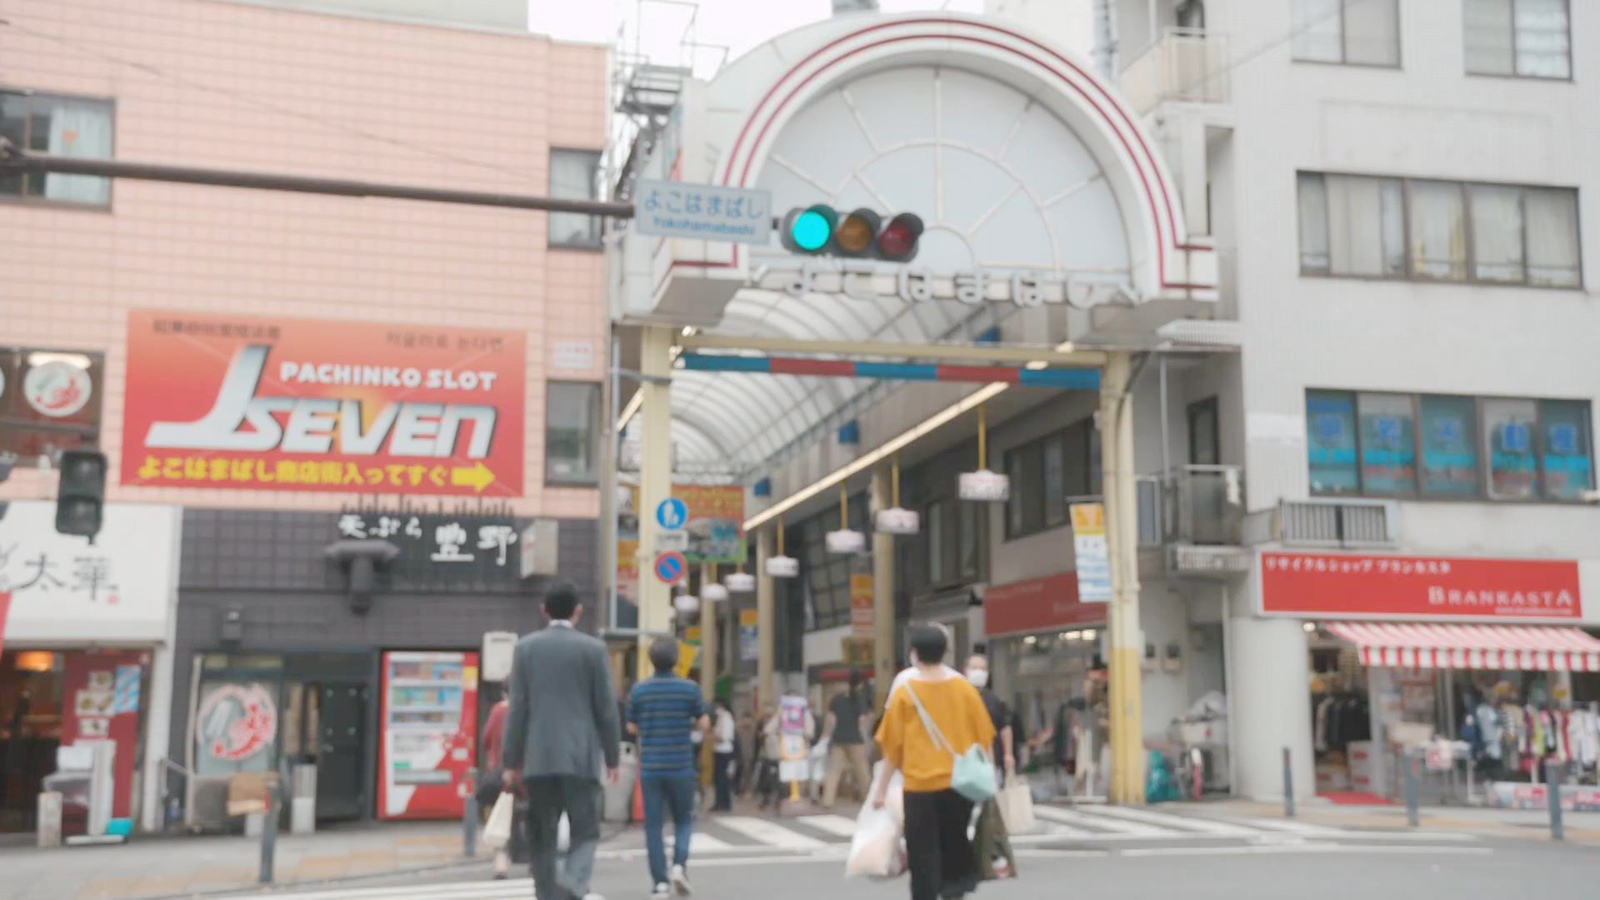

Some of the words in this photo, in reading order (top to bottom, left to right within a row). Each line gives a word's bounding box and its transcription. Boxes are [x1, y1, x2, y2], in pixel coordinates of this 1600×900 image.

[644, 189, 765, 219] よこはまばし
[653, 216, 757, 235] Yokohamabashi
[280, 360, 422, 388] PACHINKO
[426, 369, 498, 391] SLOT
[138, 455, 448, 487] よこはまばし商店街入ってすぐ
[1265, 556, 1374, 574] リサイクルショップ
[1428, 586, 1574, 608] BRANKASTA
